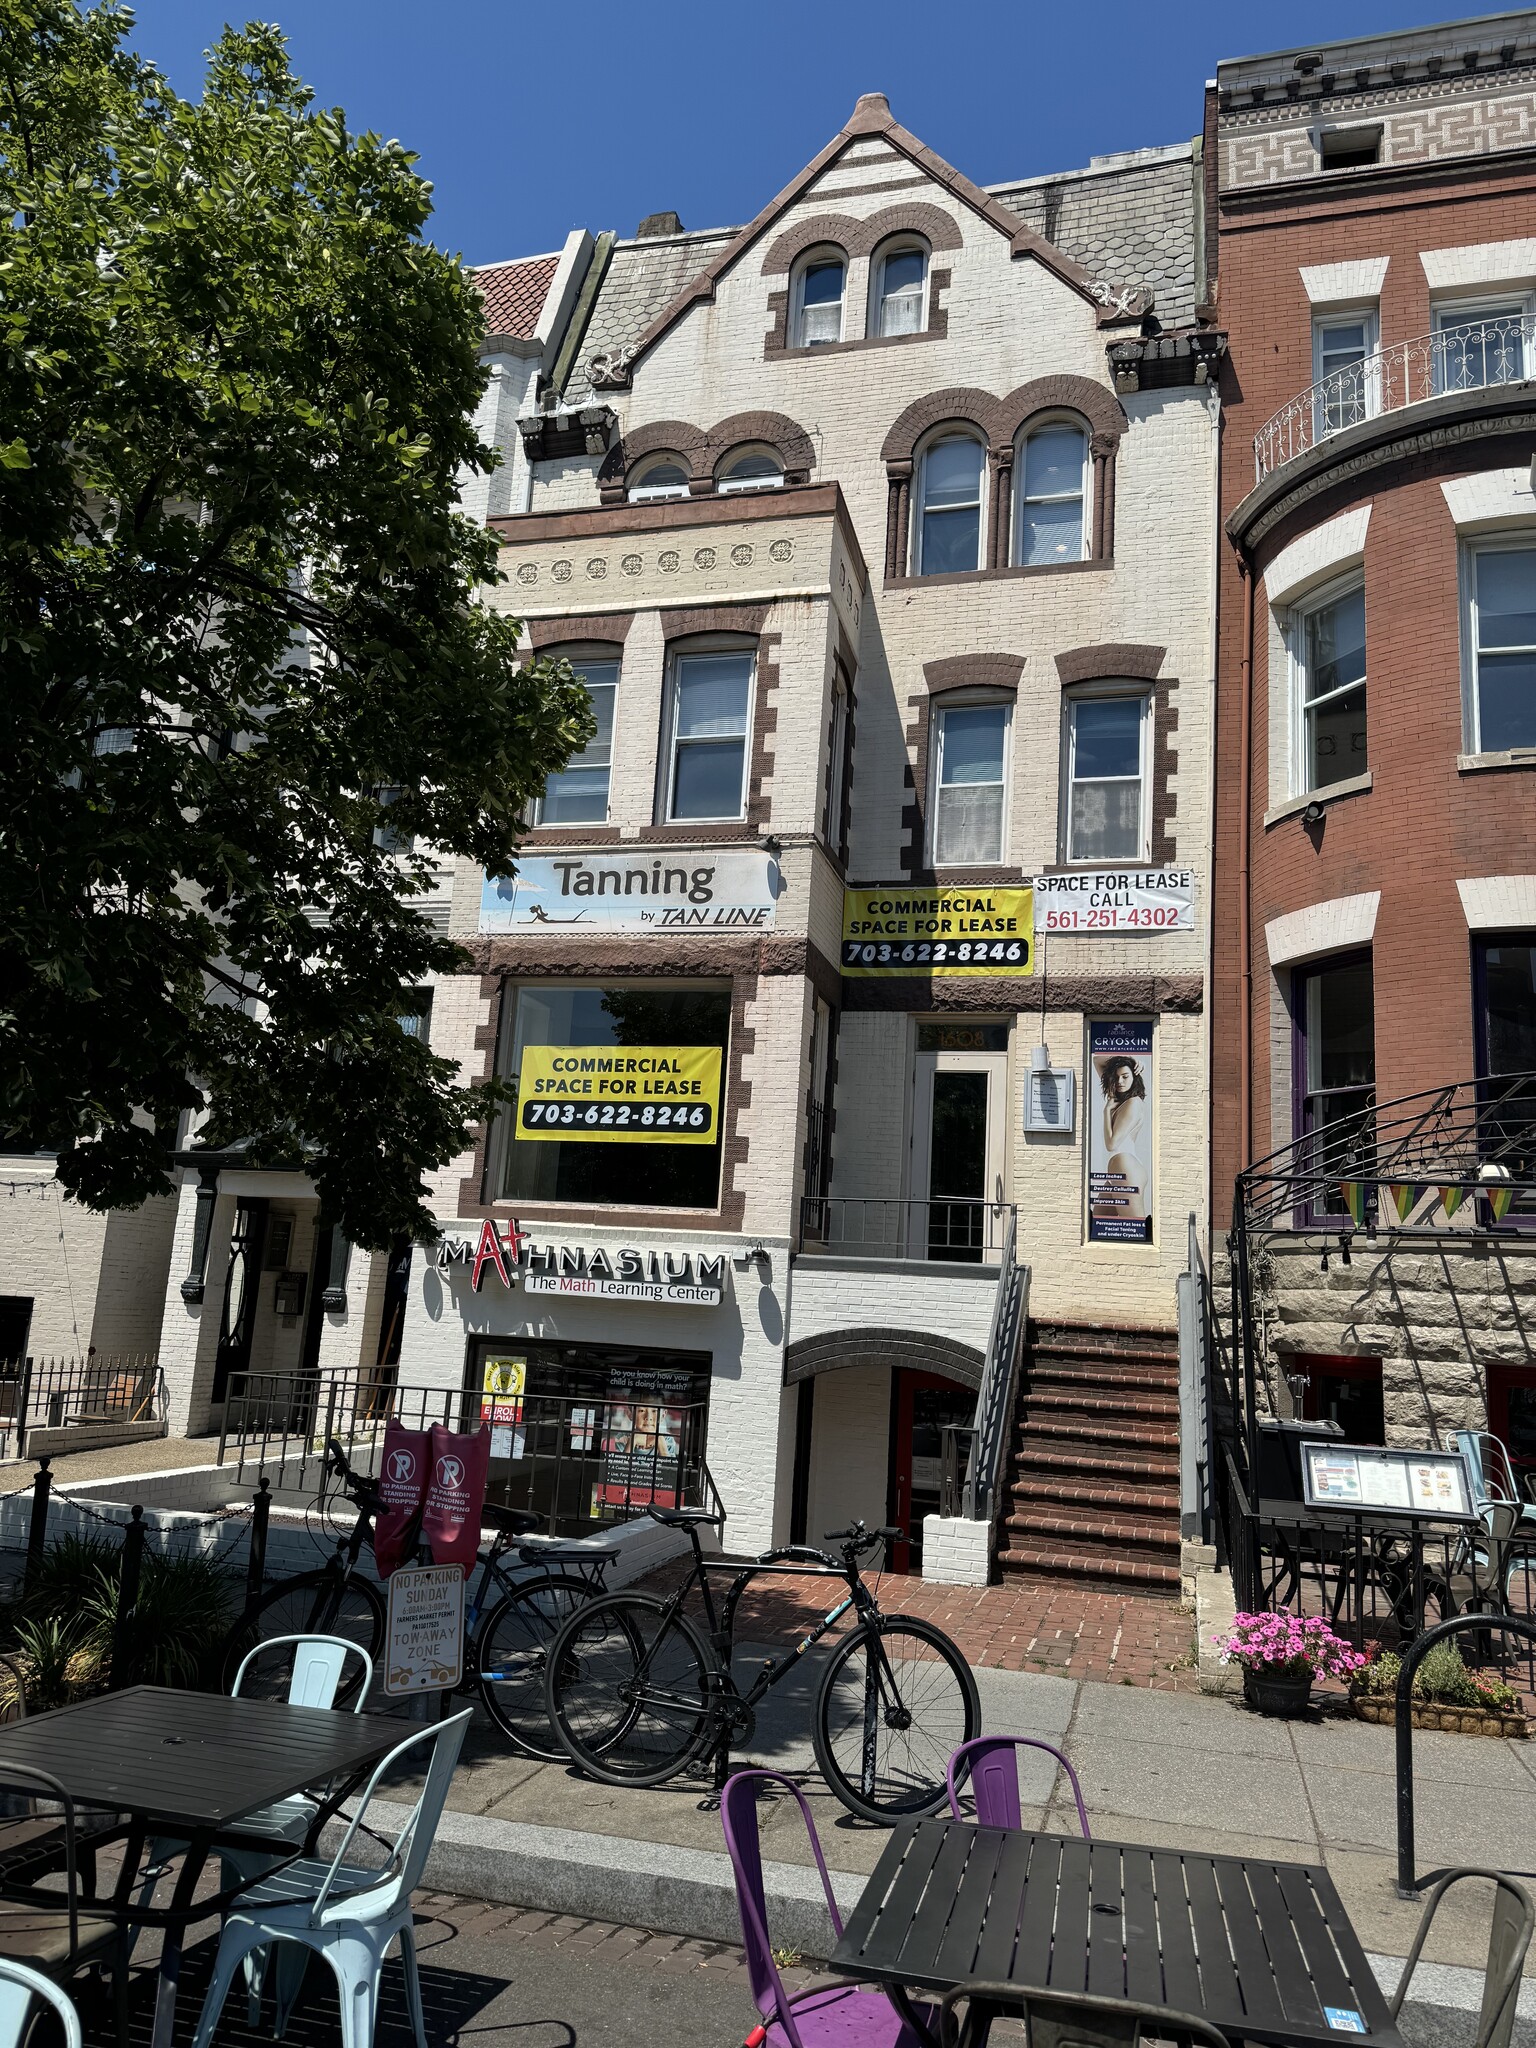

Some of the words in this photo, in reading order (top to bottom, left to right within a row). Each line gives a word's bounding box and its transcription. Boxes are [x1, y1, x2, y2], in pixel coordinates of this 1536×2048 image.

[553, 860, 716, 904] Tanning
[1037, 876, 1089, 892] SPACE
[1095, 874, 1129, 891] FOR
[1135, 872, 1190, 889] LEASE
[867, 898, 996, 915] COMMERCIAL
[1090, 892, 1134, 907] CALL
[641, 910, 655, 923] by
[661, 908, 711, 925] TAN
[713, 907, 771, 924] LINE
[1046, 907, 1179, 929] 561-251-4302
[850, 919, 908, 934] SPACE
[914, 919, 952, 933] FOR
[959, 917, 1017, 932] LEASE
[847, 942, 1021, 962] 703-622-8246
[1094, 1037, 1149, 1046] CRYOSKIN
[552, 1057, 681, 1074] COMMERCIAL
[534, 1078, 592, 1094] SPACE
[598, 1079, 637, 1094] FOR
[643, 1080, 702, 1095] LEASE
[529, 1104, 704, 1126] 703-622-8246
[530, 1276, 557, 1291] The
[559, 1277, 596, 1293] Math
[600, 1279, 663, 1300] Learning
[667, 1284, 716, 1301] Center
[611, 1368, 621, 1376] Do
[622, 1371, 635, 1379] you
[637, 1370, 656, 1379] know
[657, 1371, 672, 1380] how
[610, 1377, 626, 1386] child
[627, 1379, 634, 1387] is
[635, 1380, 655, 1389] doing
[664, 1383, 688, 1391] math?
[484, 1406, 519, 1416] ENROL
[383, 1490, 416, 1498] STANDING
[391, 1484, 421, 1492] PARKING
[438, 1489, 470, 1498] PARKING
[387, 1497, 419, 1506] STOPPING
[432, 1494, 465, 1505] STANDING
[435, 1502, 470, 1512] STOPPING
[396, 1575, 411, 1590] NO
[413, 1569, 460, 1587] PARKING
[406, 1586, 449, 1604] SUNDAY
[396, 1614, 419, 1624] FARMERS
[418, 1611, 438, 1621] MARKET
[437, 1610, 455, 1618] PERMIT
[407, 1643, 441, 1659] ZONE
